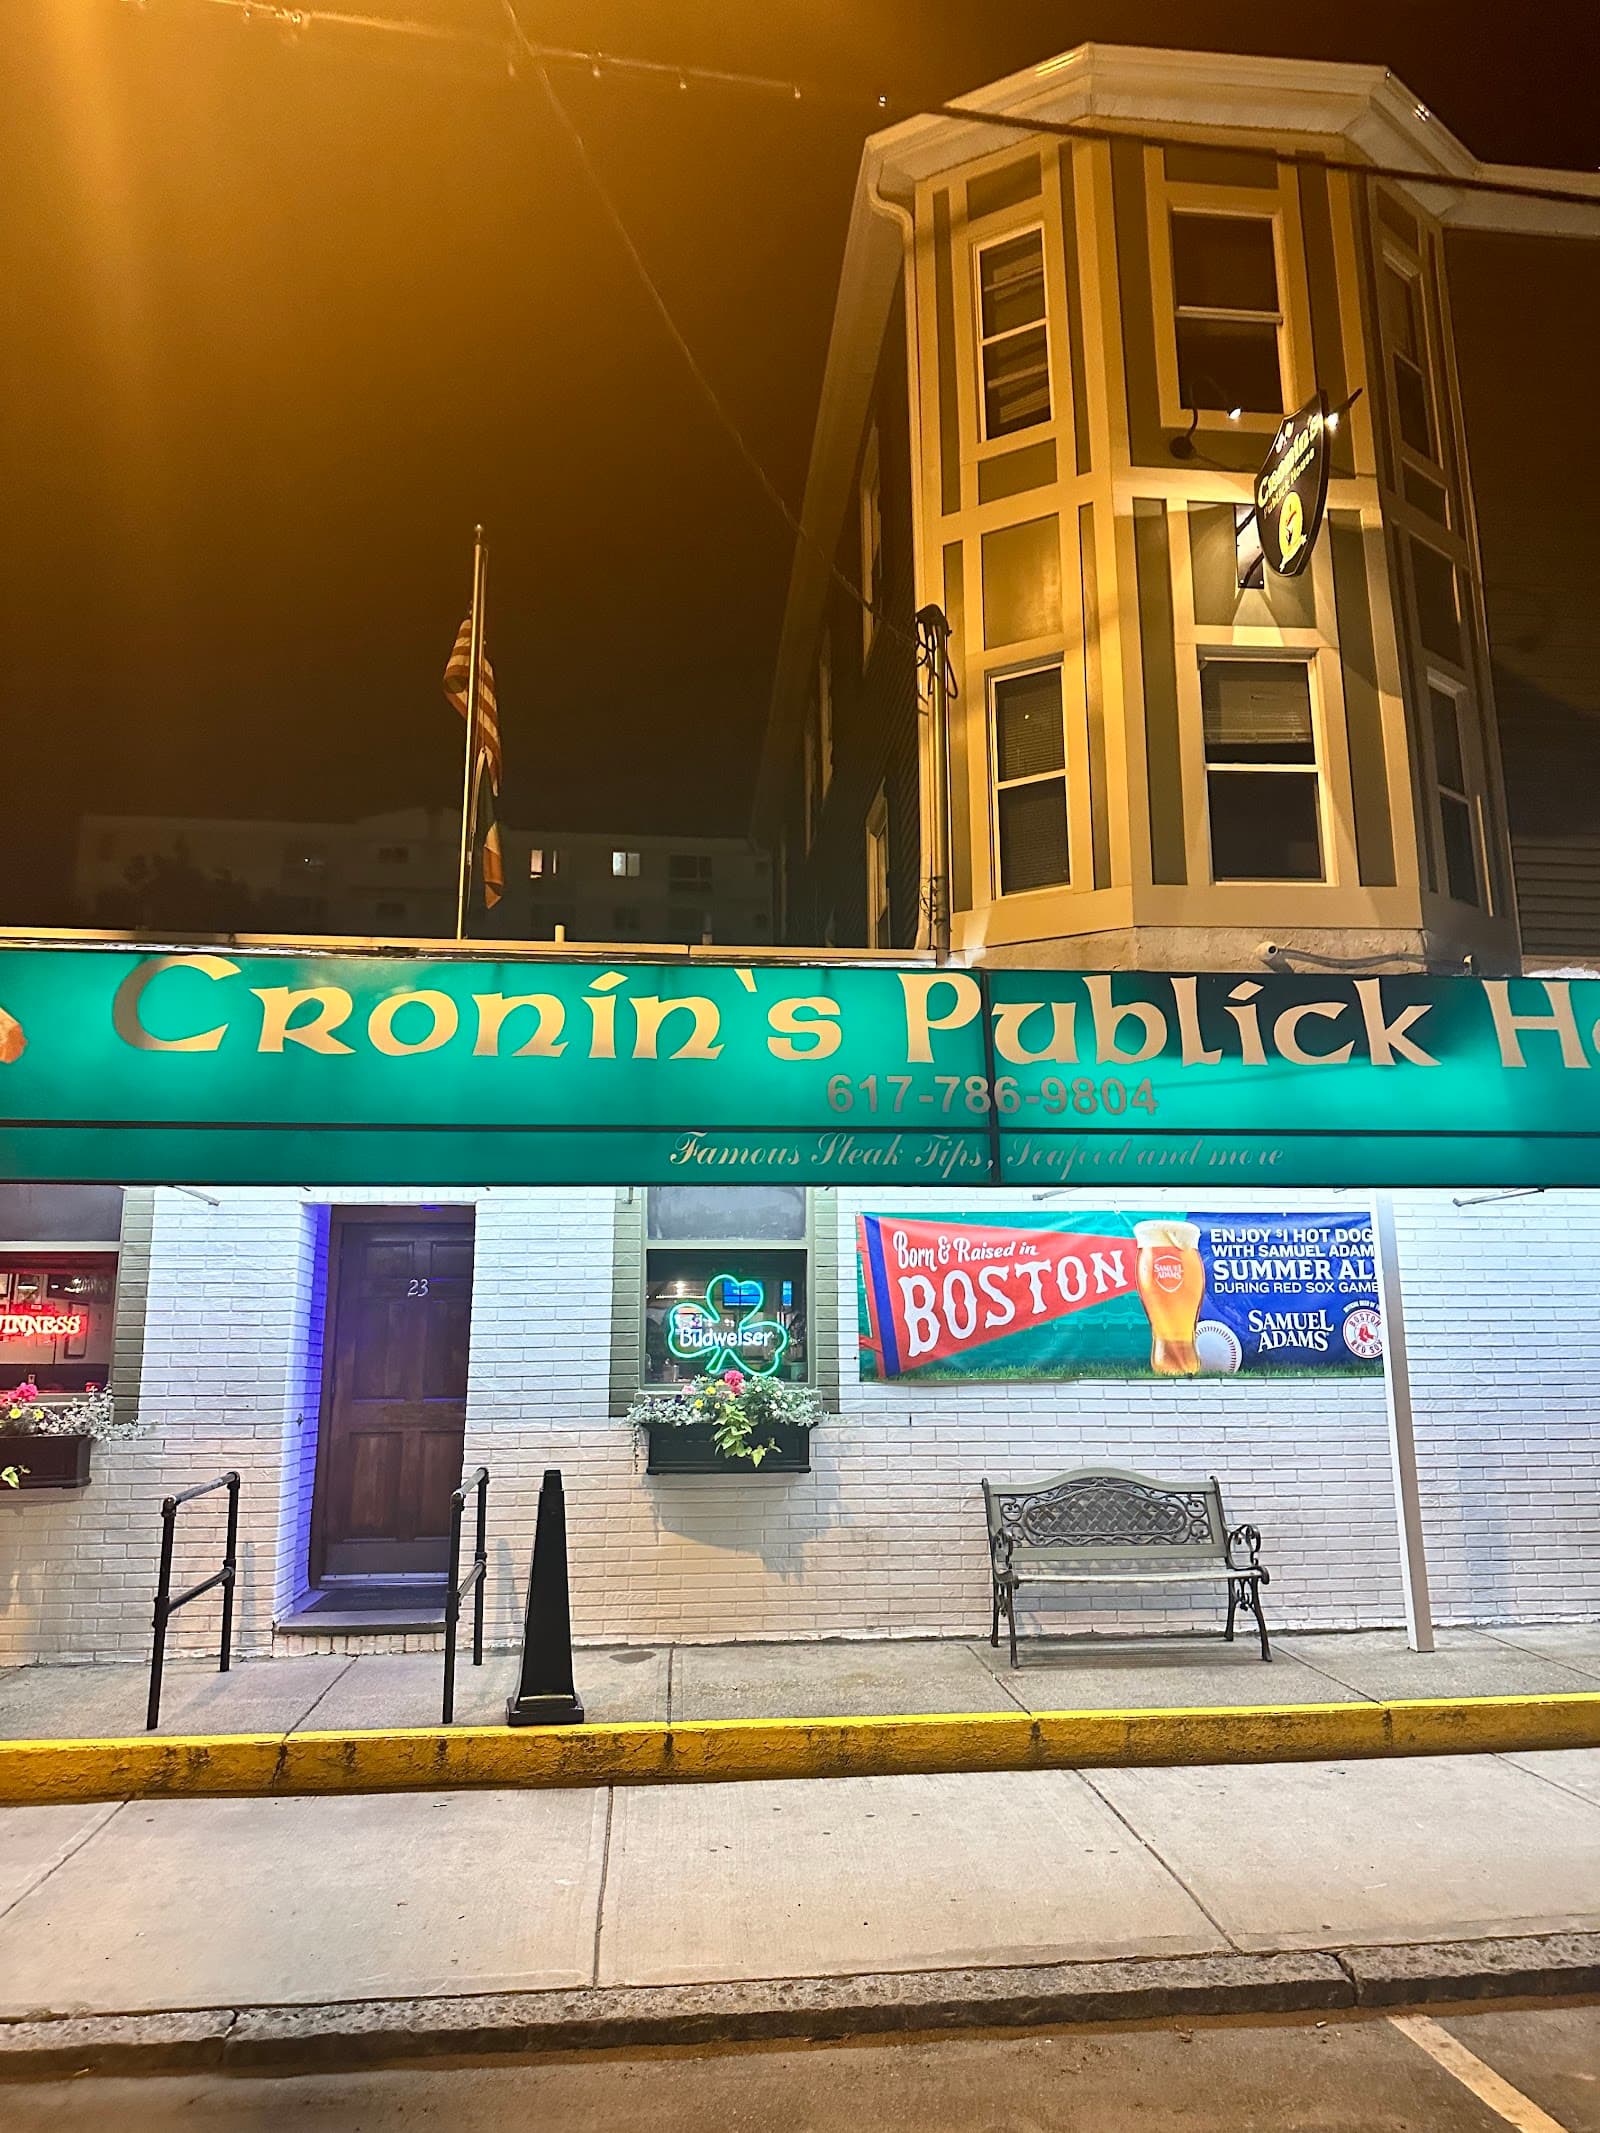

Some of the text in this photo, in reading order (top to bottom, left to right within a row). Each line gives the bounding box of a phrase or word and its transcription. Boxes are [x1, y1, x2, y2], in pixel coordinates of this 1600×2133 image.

[897, 973, 1442, 1068] Publick
[1482, 978, 1600, 1069] H
[827, 1074, 1158, 1115] 617-786-9804
[670, 1131, 1284, 1181] Famous Steak Tips, Seafood and more
[1210, 1229, 1271, 1243] ENJOY
[1293, 1229, 1330, 1243] HOT
[893, 1231, 1039, 1272] Born & Raised in
[1212, 1245, 1254, 1258] WITH
[1258, 1245, 1326, 1258] SAMUEL
[1213, 1259, 1377, 1281] SUMMER AL
[408, 1278, 429, 1297] 23
[1214, 1282, 1269, 1294] DURING
[1273, 1282, 1302, 1294] RED
[1306, 1282, 1335, 1294] SOX
[898, 1250, 1128, 1357] BOSTON
[1248, 1309, 1334, 1332] SAMUEL
[1349, 1313, 1382, 1327] BOSTON
[679, 1326, 774, 1347] Budweiser
[1258, 1330, 1329, 1352] ADAMS
